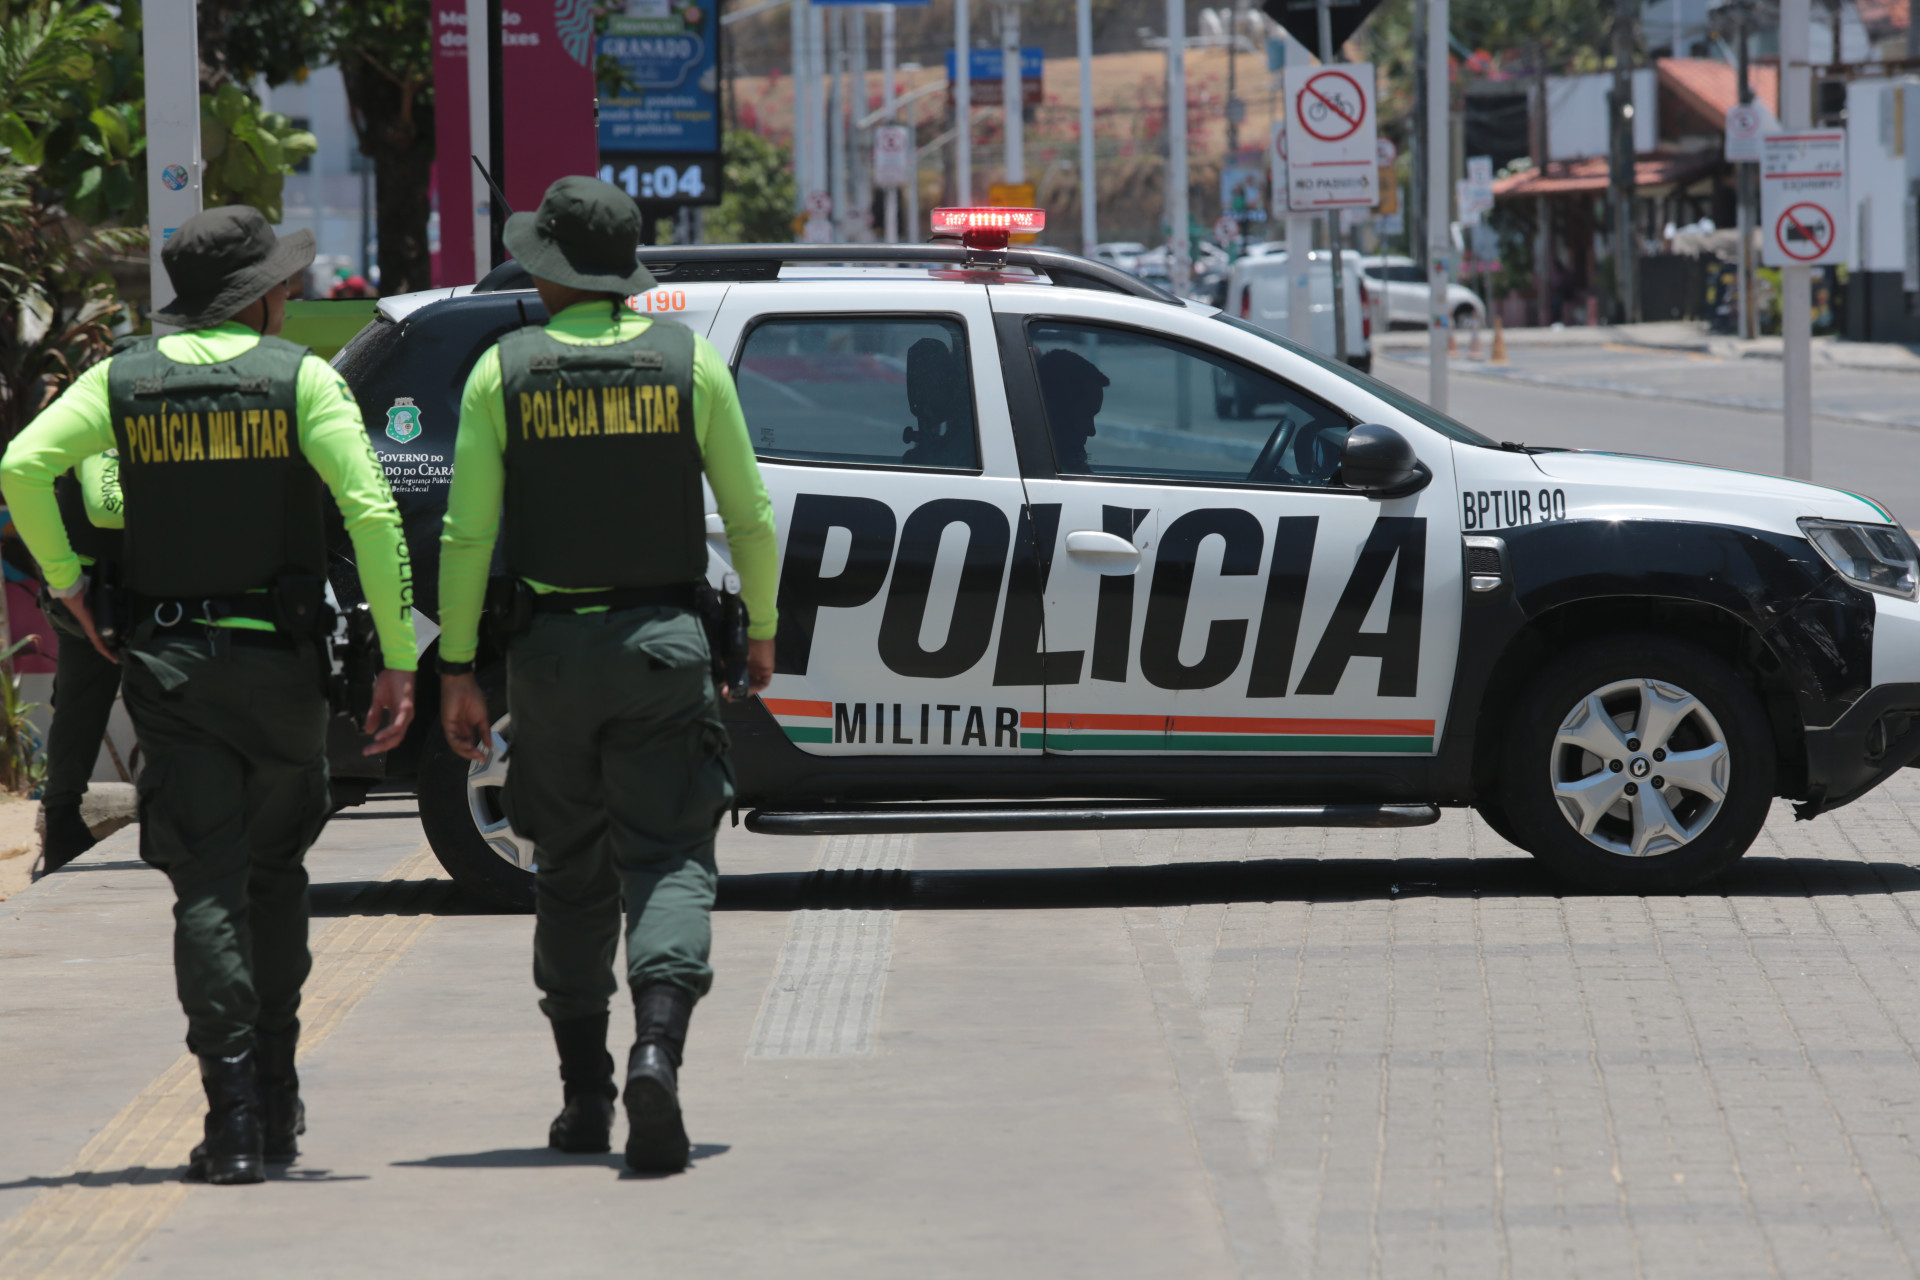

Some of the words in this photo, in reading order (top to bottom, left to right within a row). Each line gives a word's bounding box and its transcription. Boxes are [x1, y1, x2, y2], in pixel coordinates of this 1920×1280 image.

[602, 38, 691, 59] GRANADO
[596, 163, 705, 198] 11:04
[642, 290, 686, 312] 190
[520, 378, 599, 440] POLÍCIA
[602, 385, 679, 435] MILITAR
[124, 401, 205, 464] POLÍCIA
[208, 408, 289, 460] MILITAR
[376, 450, 429, 463] GOVERNO
[402, 477, 431, 486] Segurança
[1463, 490, 1532, 530] BPTUR
[1538, 488, 1566, 523] 90
[774, 493, 1427, 698] POLÍCIA
[835, 702, 1020, 748] MILITAR
